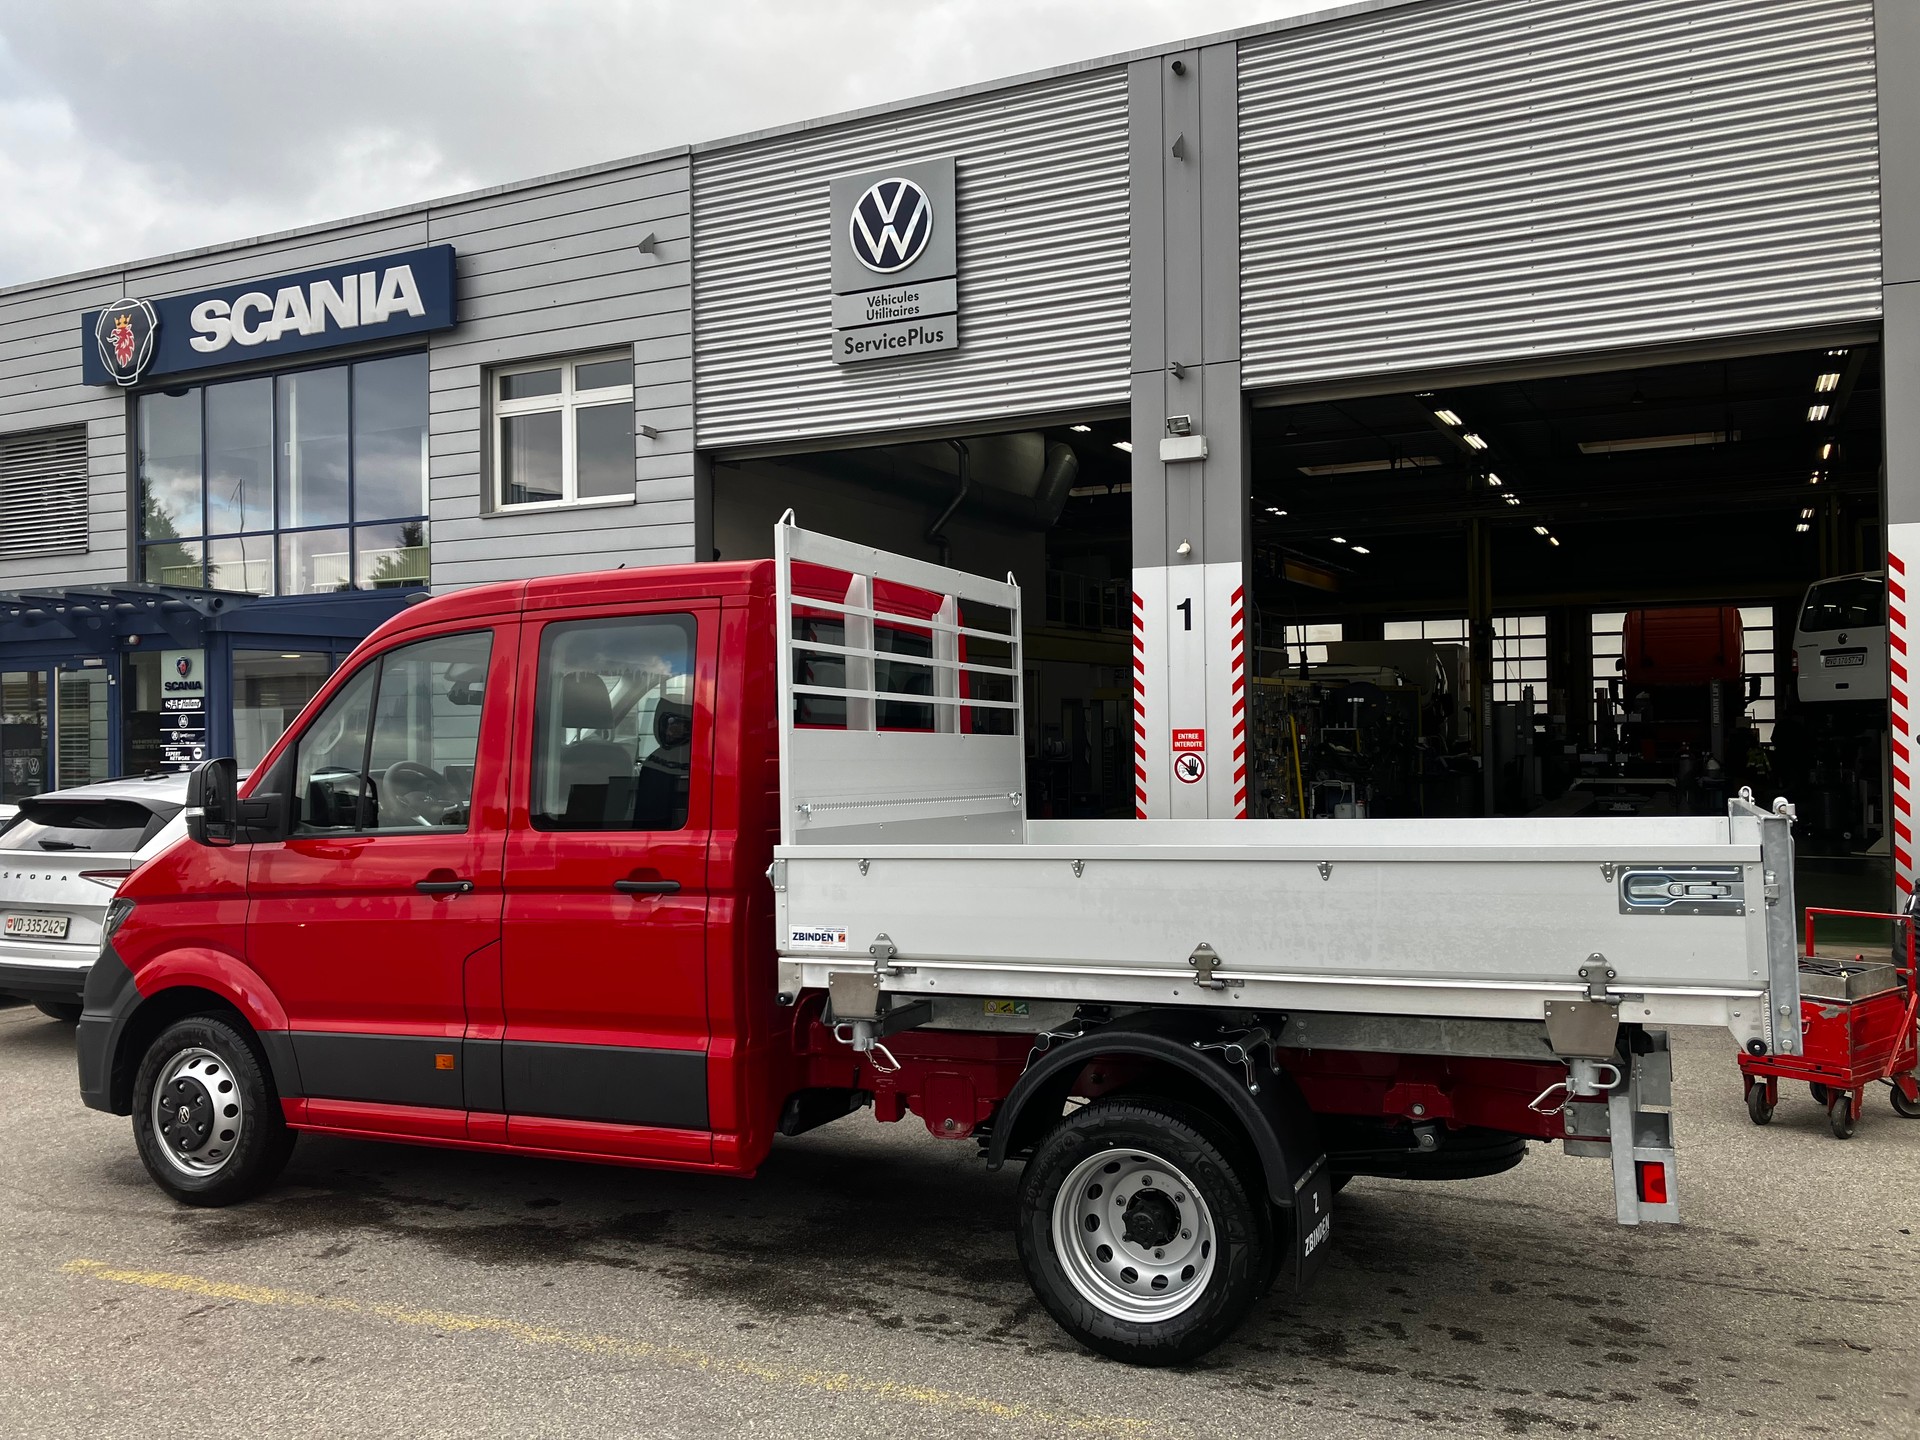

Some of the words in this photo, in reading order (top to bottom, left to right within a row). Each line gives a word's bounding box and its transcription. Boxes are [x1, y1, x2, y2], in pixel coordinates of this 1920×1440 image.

[189, 264, 426, 353] SCANIA
[867, 290, 920, 308] Véhicules
[866, 304, 920, 321] Utilitaires
[844, 326, 944, 355] ServicePlus
[1177, 598, 1191, 630] 1
[164, 681, 202, 691] SCANIA
[792, 932, 834, 942] ZBINDEN
[1304, 1212, 1330, 1257] ZBINDEN
